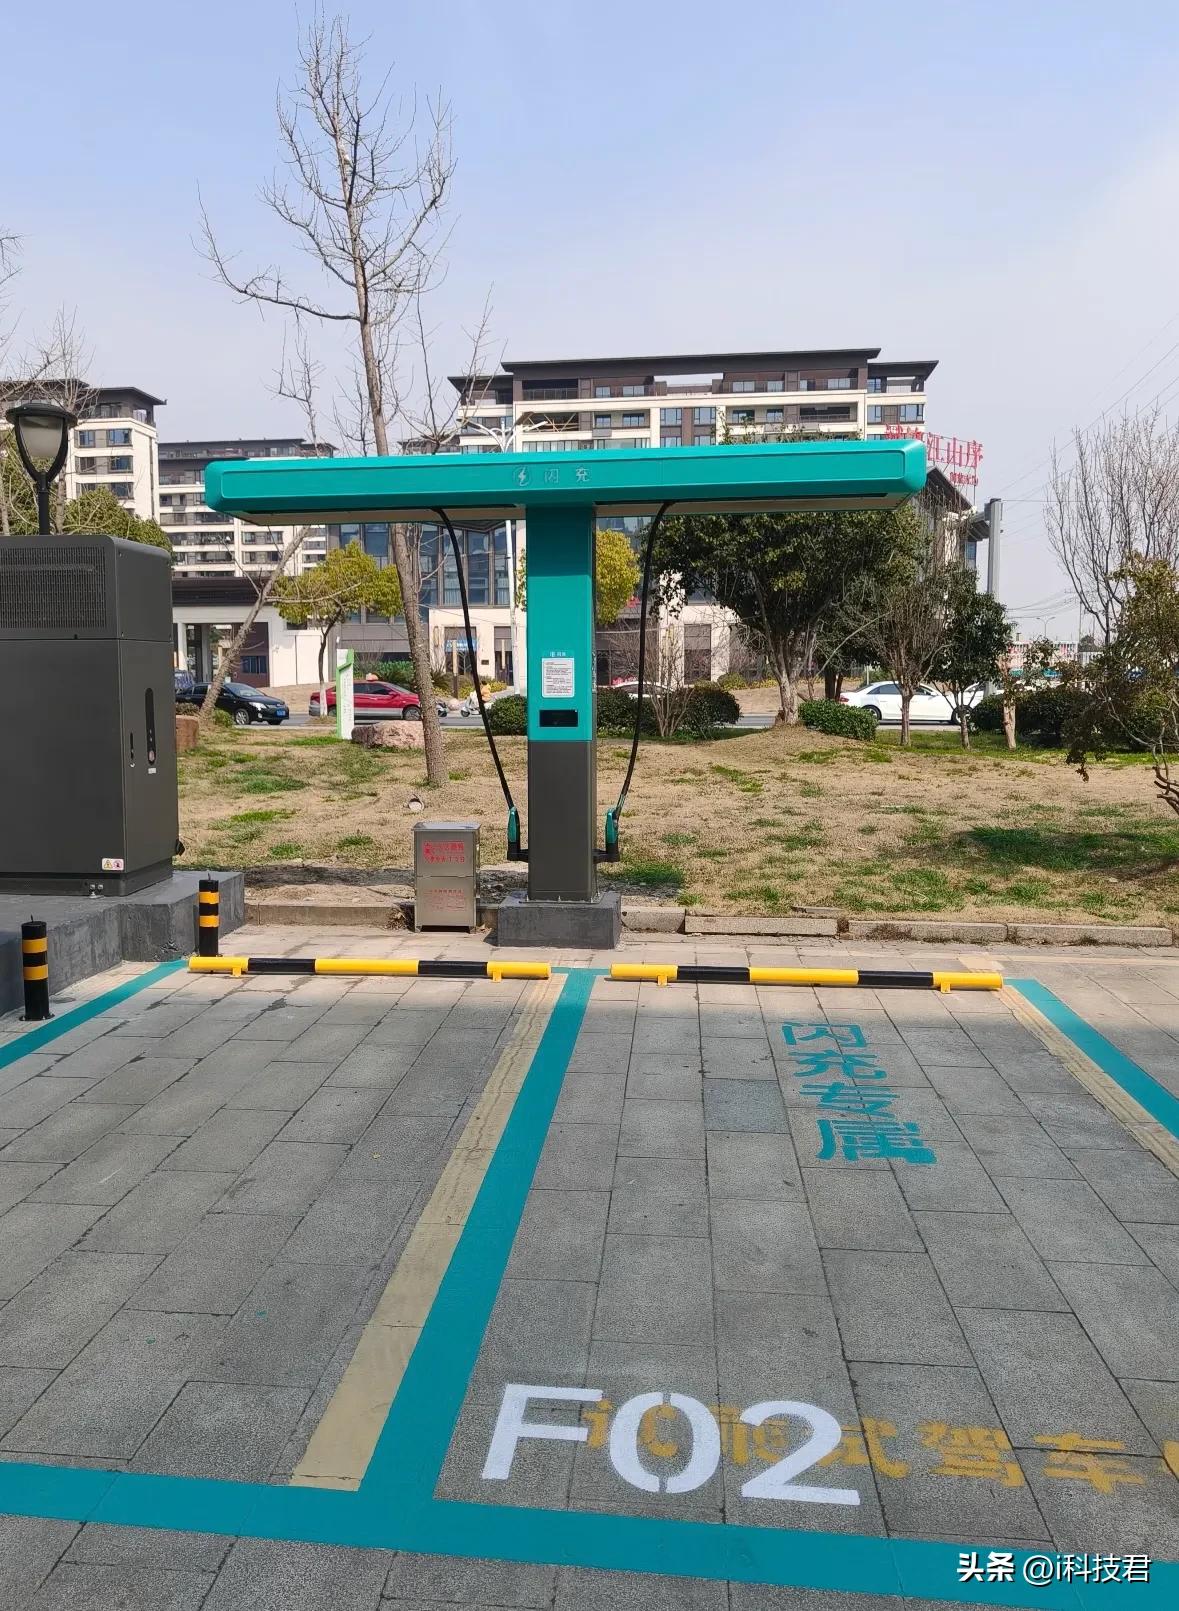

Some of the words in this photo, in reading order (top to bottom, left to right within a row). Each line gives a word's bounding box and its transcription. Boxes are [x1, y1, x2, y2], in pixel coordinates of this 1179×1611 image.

[544, 466, 590, 484] 闪充
[782, 1022, 937, 1165] 闪充专属
[482, 1383, 861, 1507] F02
